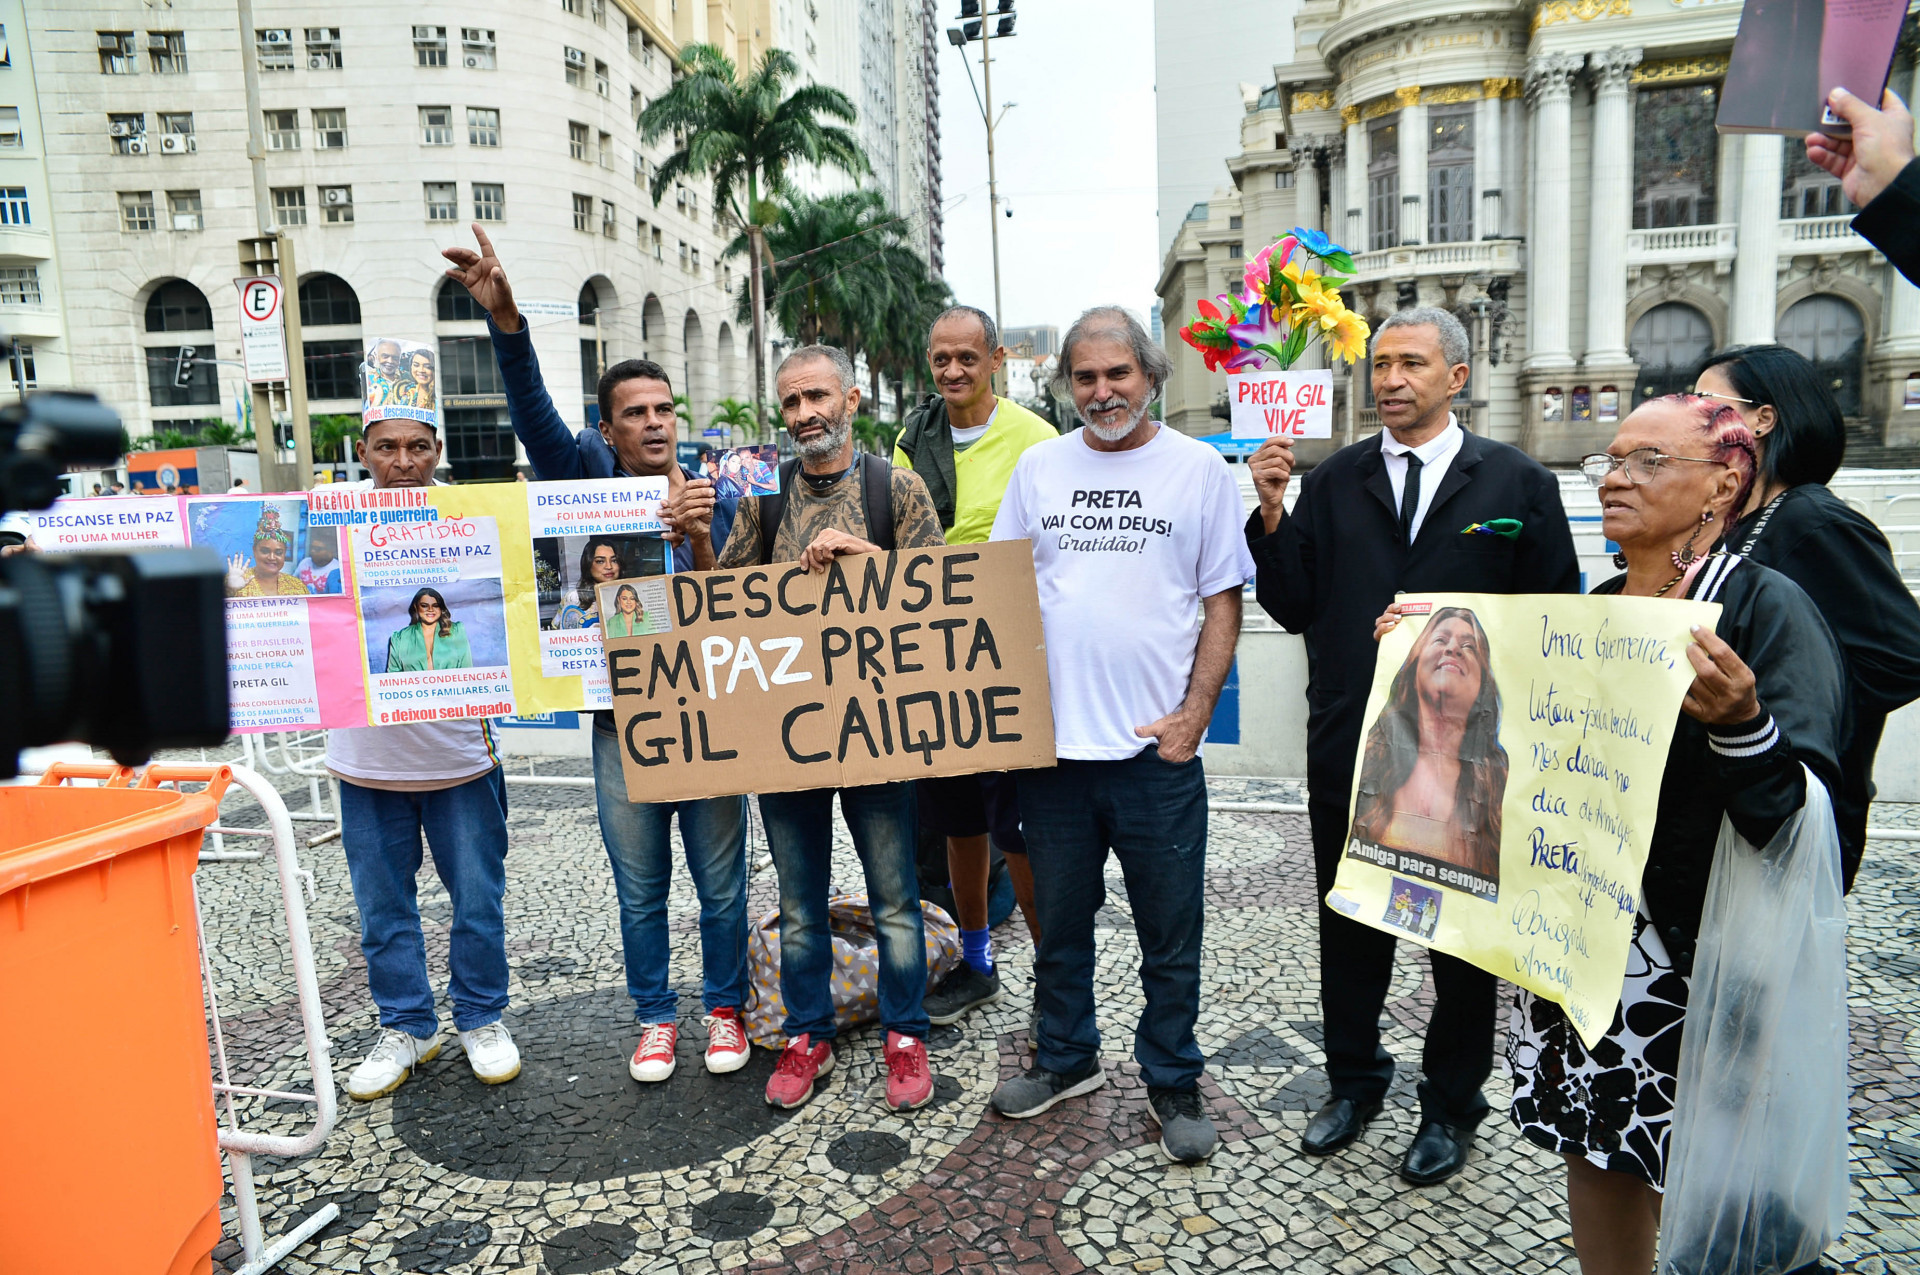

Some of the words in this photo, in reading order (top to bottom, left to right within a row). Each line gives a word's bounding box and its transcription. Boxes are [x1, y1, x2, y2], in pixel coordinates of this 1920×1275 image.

[254, 288, 266, 311] E
[1238, 380, 1287, 405] PRETA
[1296, 384, 1326, 407] GIL
[384, 406, 415, 418] descanse
[415, 410, 425, 420] em
[1264, 408, 1306, 435] VIVE
[537, 492, 608, 506] DESCANSE
[612, 491, 631, 503] EM
[636, 490, 661, 501] PAZ
[1071, 490, 1142, 509] PRETA
[37, 514, 114, 528] DESCANSE
[119, 512, 141, 525] EM
[146, 511, 175, 523] PAZ
[309, 509, 367, 527] exemplar
[370, 511, 378, 523] e
[380, 507, 438, 525] guerreira
[557, 512, 574, 521] FOI
[577, 510, 601, 520] UMA
[604, 508, 647, 518] MULHER
[544, 524, 602, 535] BRASILEIRA
[605, 521, 662, 532] GUERREIRA
[1041, 515, 1065, 531] VAI
[1070, 515, 1113, 531] COM
[1119, 516, 1172, 538] DEUS!
[59, 534, 78, 543] FOI
[81, 533, 108, 543] UMA
[111, 530, 159, 541] MULHER
[1058, 533, 1147, 554] Gratidão!
[364, 546, 437, 562] DESCANSE
[440, 546, 461, 558] EM
[465, 544, 491, 556] PAZ
[363, 560, 395, 568] MINHAS
[396, 558, 451, 567] CONDELENCIAS
[390, 569, 400, 577] OS
[374, 578, 401, 586] RESTA
[402, 576, 448, 585] SAUDADES
[673, 551, 979, 627] DESCANSE
[279, 598, 299, 606] PAZ
[236, 612, 254, 620] UMA
[256, 611, 288, 619] MULHER
[257, 620, 299, 628] GUERREIRA
[549, 635, 589, 645] MINHAS
[256, 649, 287, 658] CHORA
[289, 649, 305, 657] UM
[548, 648, 582, 658] TODOS
[585, 647, 597, 656] OS
[609, 638, 700, 699] EM
[701, 635, 813, 700] PAZ
[822, 617, 1002, 686] PRETA
[265, 661, 293, 670] PERCA
[562, 659, 597, 670] RESTA
[232, 678, 268, 689] PRETA
[271, 677, 288, 687] GIL
[379, 676, 420, 687] MINHAS
[422, 671, 498, 684] CONDELENCIAS
[378, 690, 413, 701] TODOS
[415, 689, 429, 698] OS
[494, 684, 510, 693] GIL
[252, 698, 306, 708] CONDELENCIAS
[380, 712, 389, 723] e
[392, 708, 436, 722] deixou
[439, 706, 464, 719] seu
[465, 701, 512, 718] legado
[231, 719, 257, 727] RESTA
[258, 716, 304, 726] SAUDADES
[1532, 787, 1569, 817] dia
[1348, 838, 1397, 866] Amiga
[1399, 855, 1436, 878] para
[1439, 867, 1498, 897] sempre
